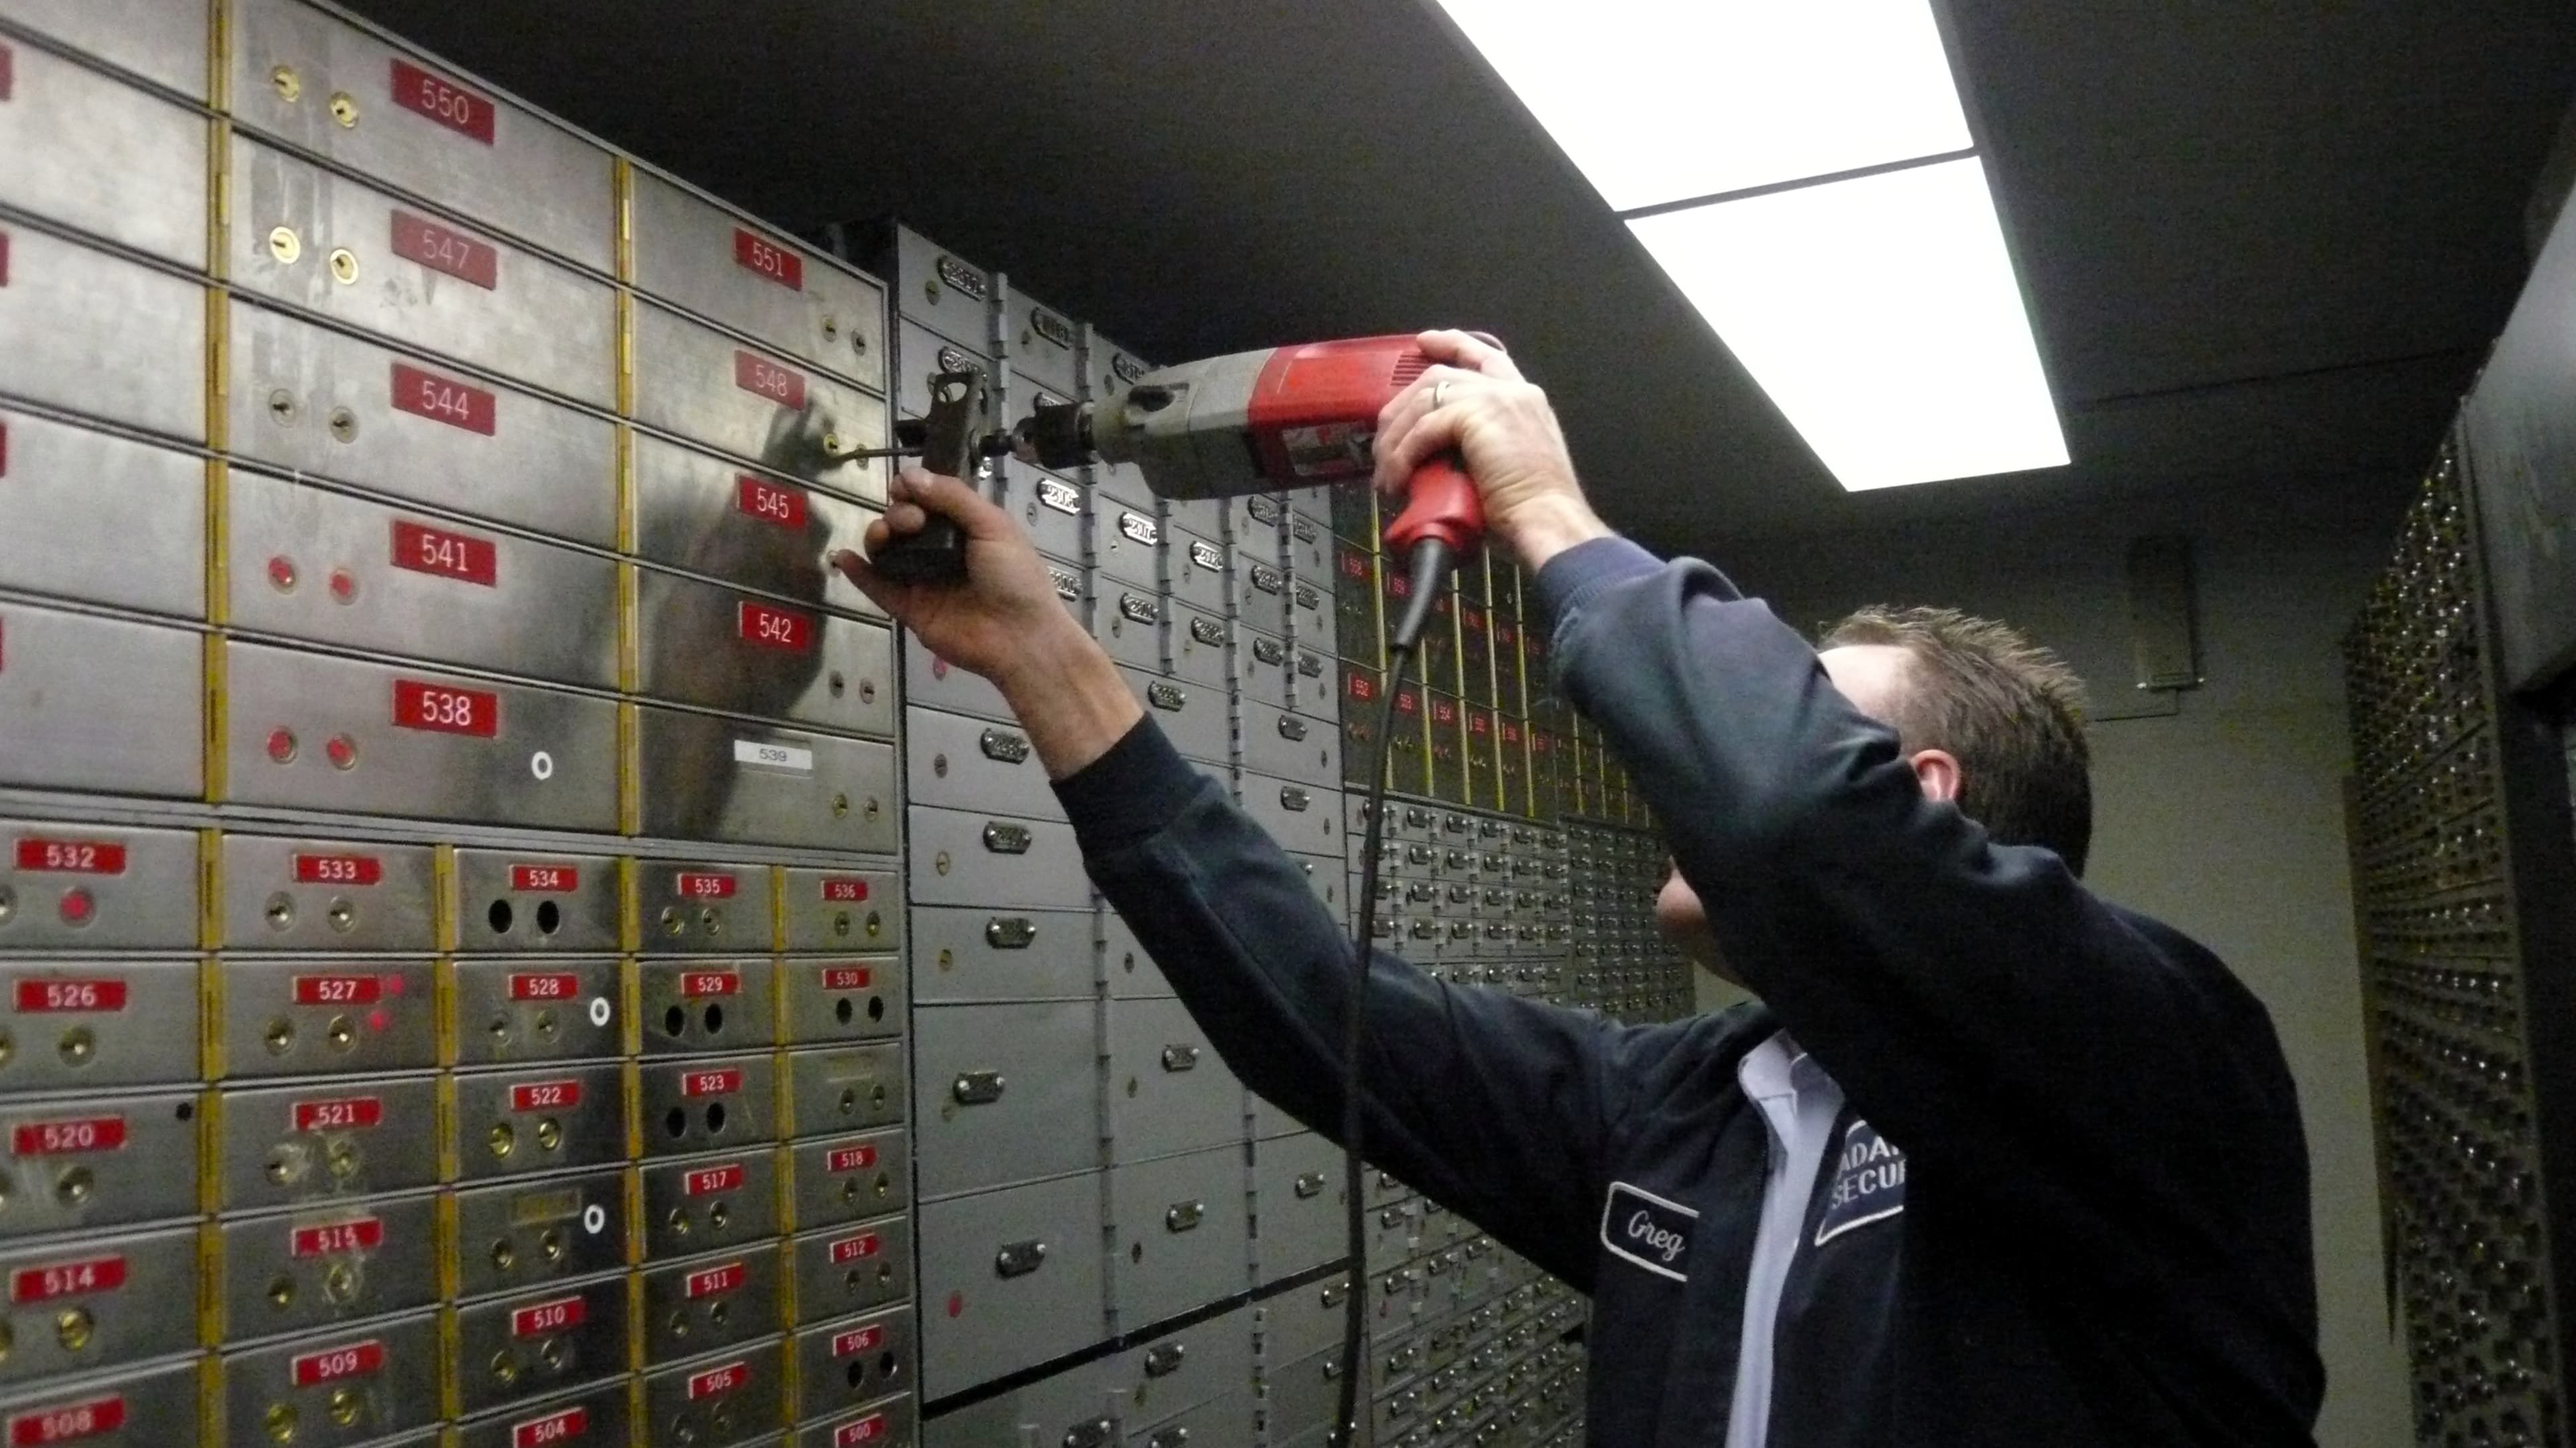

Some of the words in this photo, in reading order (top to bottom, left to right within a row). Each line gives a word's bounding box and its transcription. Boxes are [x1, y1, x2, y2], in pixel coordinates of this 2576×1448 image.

[421, 80, 469, 125] 550
[422, 229, 470, 271] 547
[753, 242, 784, 276] 551
[755, 364, 788, 397] 548
[421, 380, 470, 421] 544
[756, 487, 790, 519] 545
[421, 534, 468, 572] 541
[759, 613, 792, 643] 542
[421, 691, 472, 727] 538
[759, 747, 788, 762] 539
[46, 845, 95, 868] 532
[317, 860, 358, 880] 533
[529, 870, 559, 888] 534
[694, 877, 720, 895] 535
[835, 882, 855, 899] 536
[528, 978, 559, 996] 528
[697, 975, 724, 992] 529
[836, 970, 858, 986] 530
[47, 984, 97, 1007] 526
[318, 980, 358, 1000] 527
[699, 1074, 725, 1092] 523
[530, 1086, 561, 1104] 522
[317, 1103, 356, 1125] 521
[44, 1125, 95, 1149] 520
[841, 1151, 863, 1167] 518
[1837, 1135, 1900, 1182] ADA
[702, 1172, 727, 1190] 517
[317, 1229, 358, 1250] 515
[1627, 1209, 1686, 1262] Greg
[843, 1241, 866, 1257] 512
[44, 1263, 95, 1293] 514
[702, 1272, 729, 1290] 511
[533, 1308, 566, 1329] 510
[846, 1333, 869, 1349] 506
[318, 1351, 358, 1378] 509
[706, 1372, 733, 1391] 505
[533, 1420, 566, 1442] 504
[848, 1425, 872, 1442] 500
